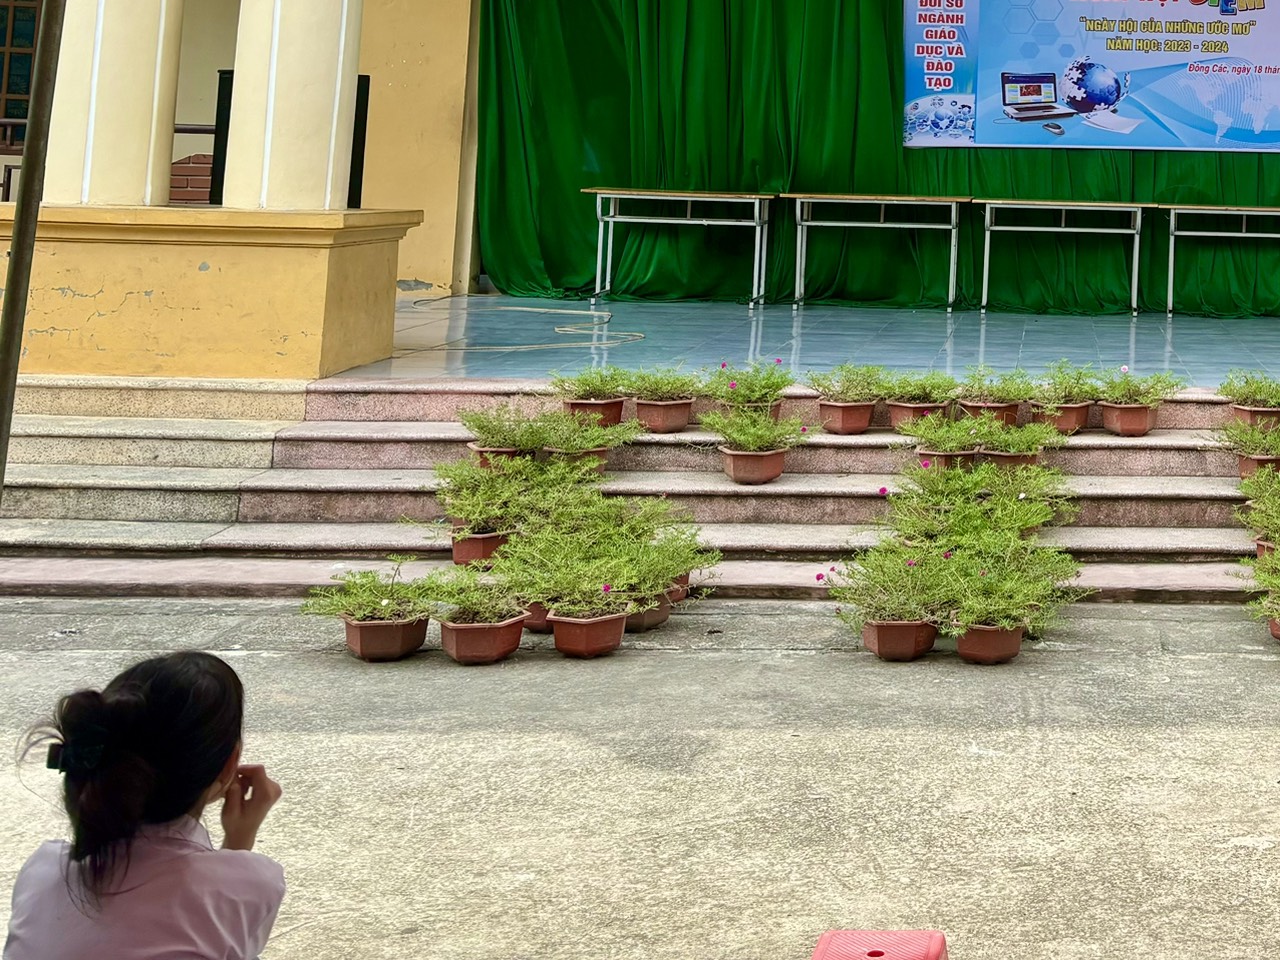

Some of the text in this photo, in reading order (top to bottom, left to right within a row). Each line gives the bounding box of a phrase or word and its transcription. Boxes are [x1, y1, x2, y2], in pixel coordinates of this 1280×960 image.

[918, 11, 964, 24] NGÀNH
[1118, 19, 1137, 35] HỘI
[1140, 18, 1163, 33] CỦA
[1165, 20, 1204, 34] NHỮNG
[1207, 21, 1229, 34] ƯỚC
[925, 27, 957, 40] GIÁO
[916, 43, 964, 58] DỤC VÀ
[1106, 37, 1132, 51] NĂM
[1135, 39, 1162, 53] HỌC:
[1164, 40, 1191, 52] 2023
[1201, 41, 1229, 53] 2024
[926, 59, 953, 72] ĐÀO
[1188, 63, 1210, 74] Đông
[1212, 63, 1229, 74] Các,
[1231, 64, 1251, 76] ngày
[1254, 65, 1263, 74] 18
[926, 77, 952, 90] TẠO
